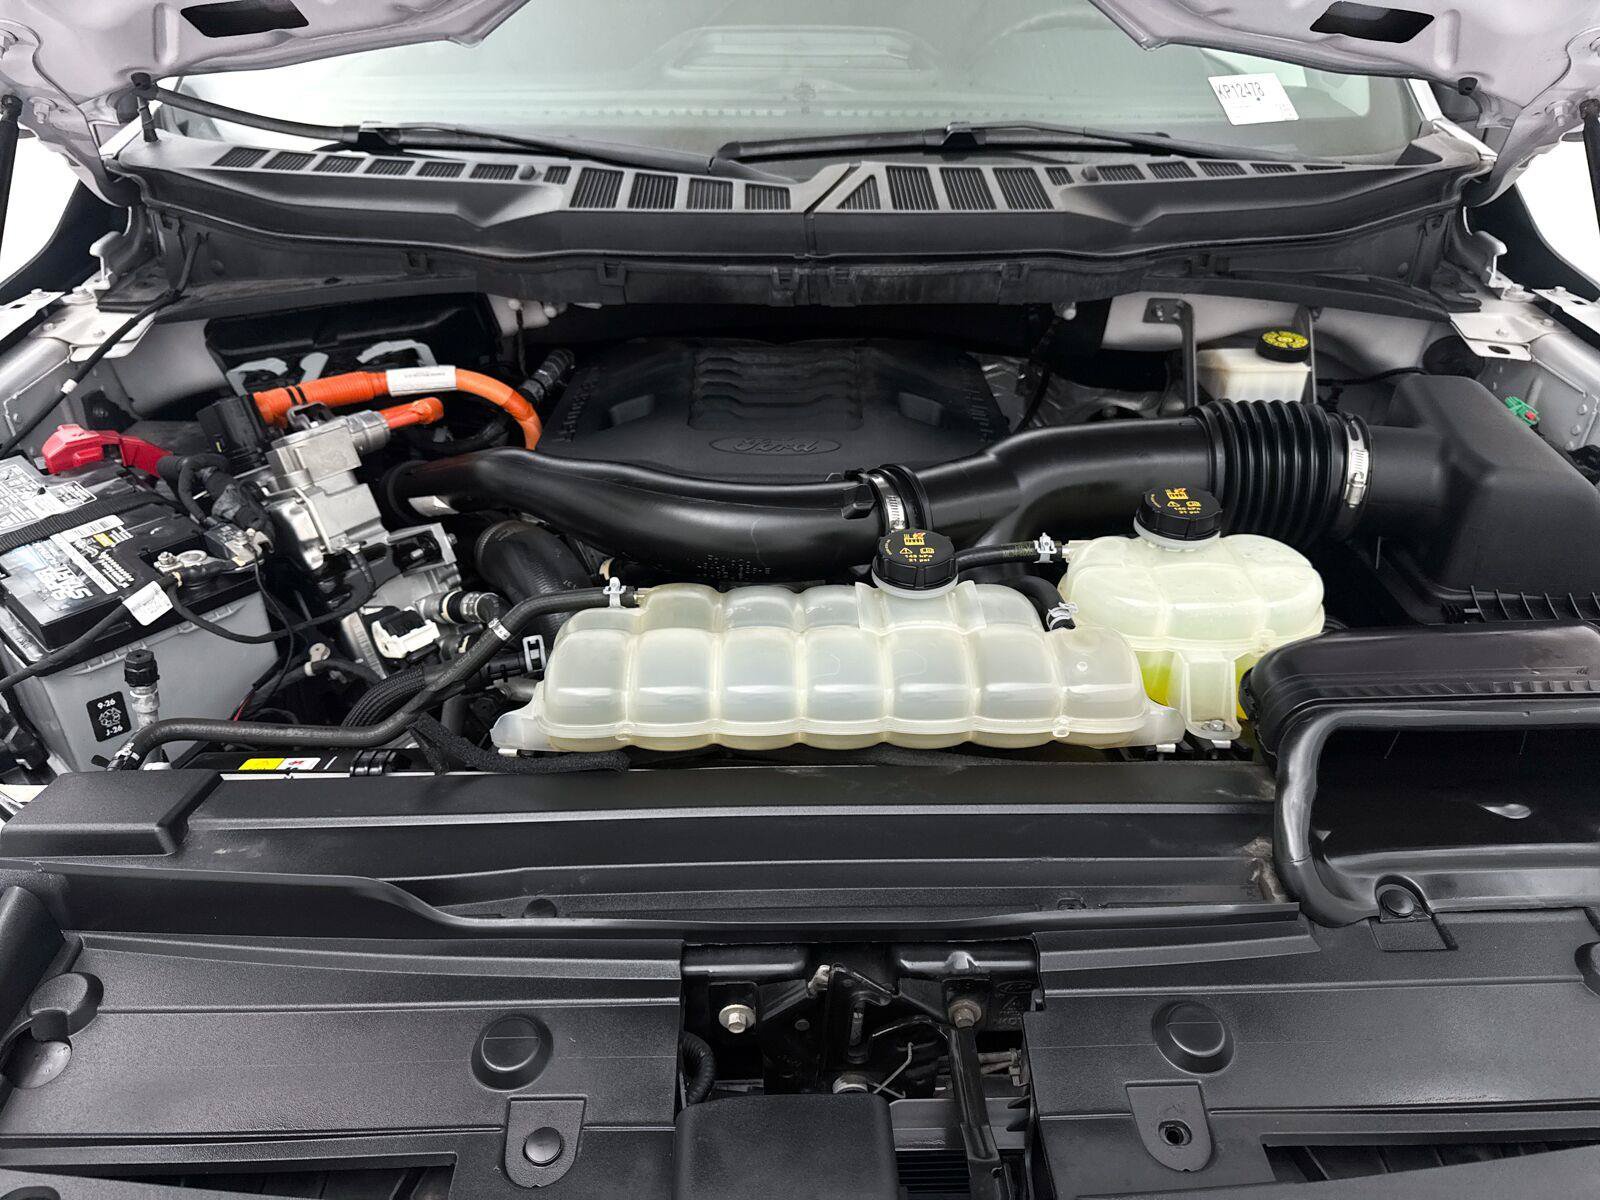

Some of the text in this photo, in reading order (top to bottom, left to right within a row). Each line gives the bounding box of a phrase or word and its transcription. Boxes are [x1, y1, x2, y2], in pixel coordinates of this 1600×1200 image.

[1215, 82, 1265, 99] KP12478
[734, 437, 820, 453] Ford
[52, 565, 94, 598] START
[97, 698, 116, 709] 9-26
